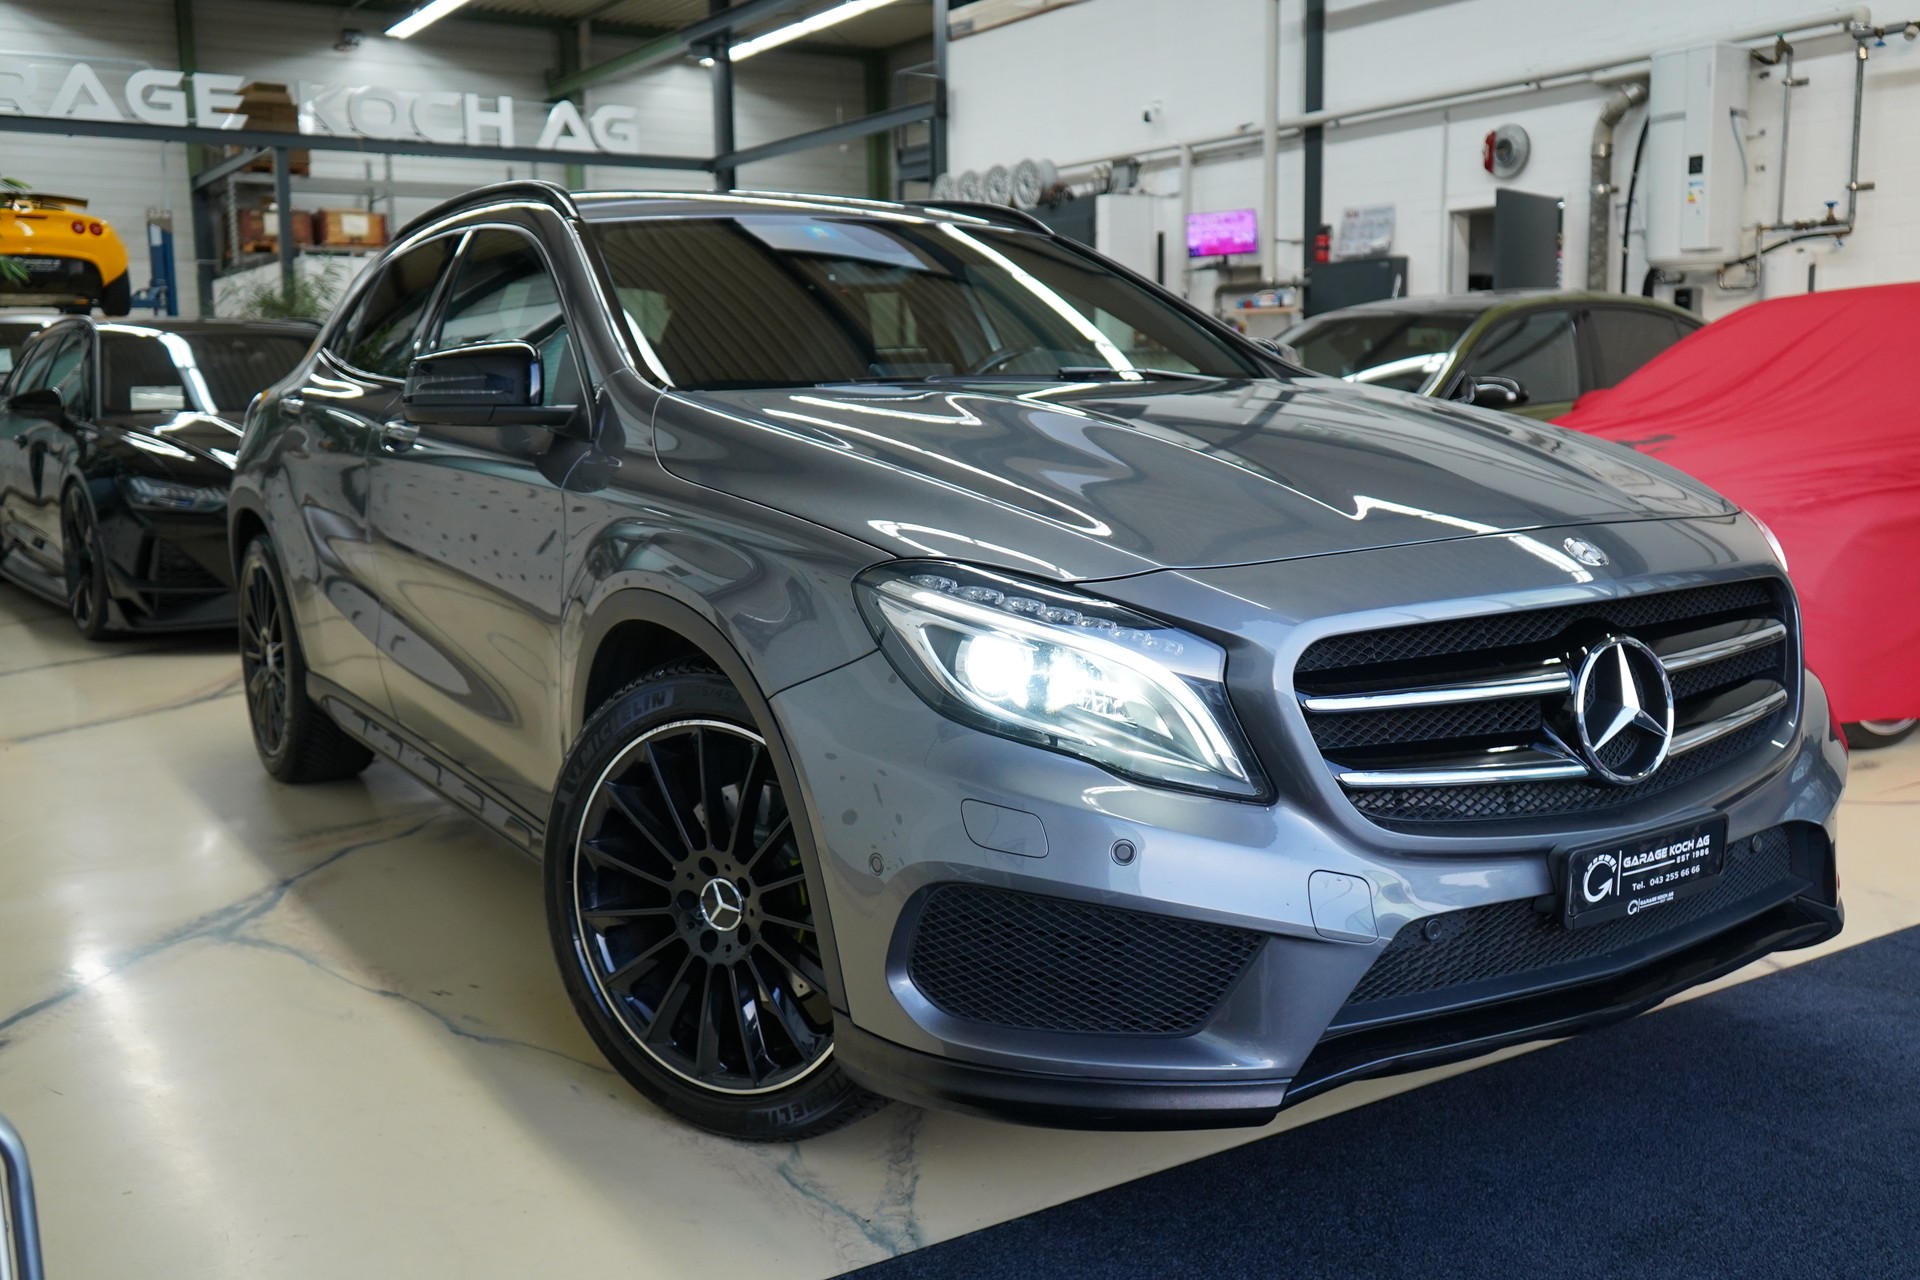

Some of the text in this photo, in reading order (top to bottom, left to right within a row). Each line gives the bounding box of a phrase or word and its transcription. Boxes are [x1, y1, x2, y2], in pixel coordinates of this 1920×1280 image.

[298, 80, 515, 147] KOCH
[537, 99, 640, 152] AG
[1623, 834, 1710, 868] GARAGE KOCH AG
[1676, 847, 1710, 863] EST 1986
[1632, 864, 1700, 891] Tel. 043 255 66 66
